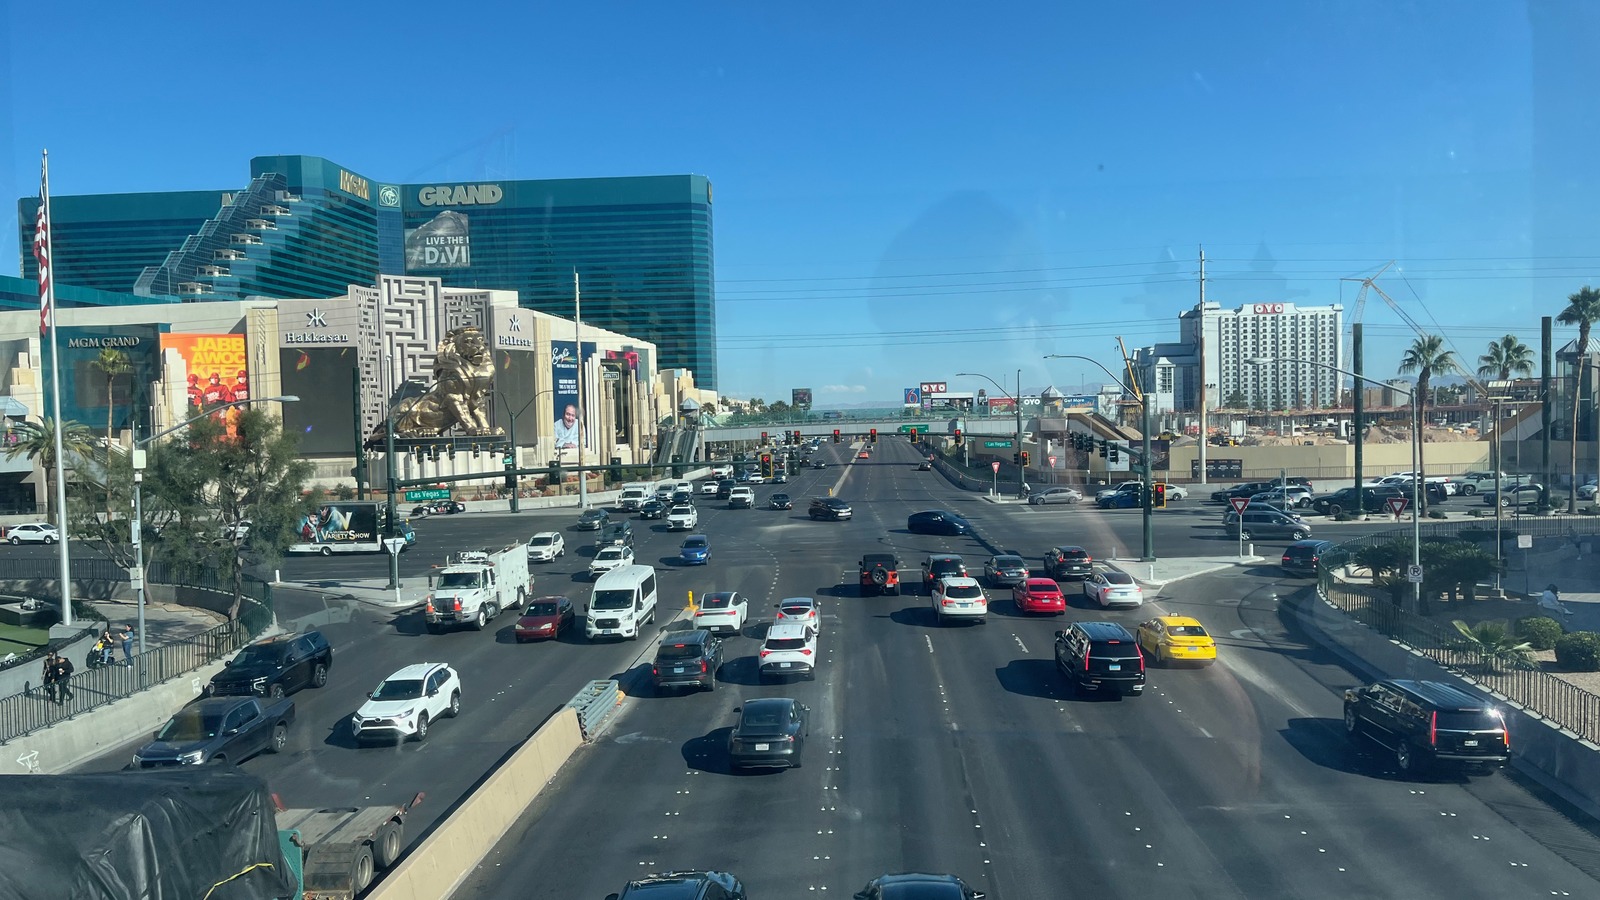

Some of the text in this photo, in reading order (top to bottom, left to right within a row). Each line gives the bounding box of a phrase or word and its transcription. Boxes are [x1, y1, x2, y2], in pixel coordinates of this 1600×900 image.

[340, 169, 503, 207] MGM GRAND
[426, 237, 445, 245] LIVE
[446, 236, 464, 245] THE
[1255, 304, 1283, 313] OYO
[68, 336, 140, 348] MGM GRAND
[285, 331, 349, 343] Hakkasan
[191, 337, 245, 352] JABB
[191, 351, 246, 364] AWOC
[921, 384, 946, 392] OYO
[906, 388, 919, 404] 6
[422, 491, 440, 499] Vegas
